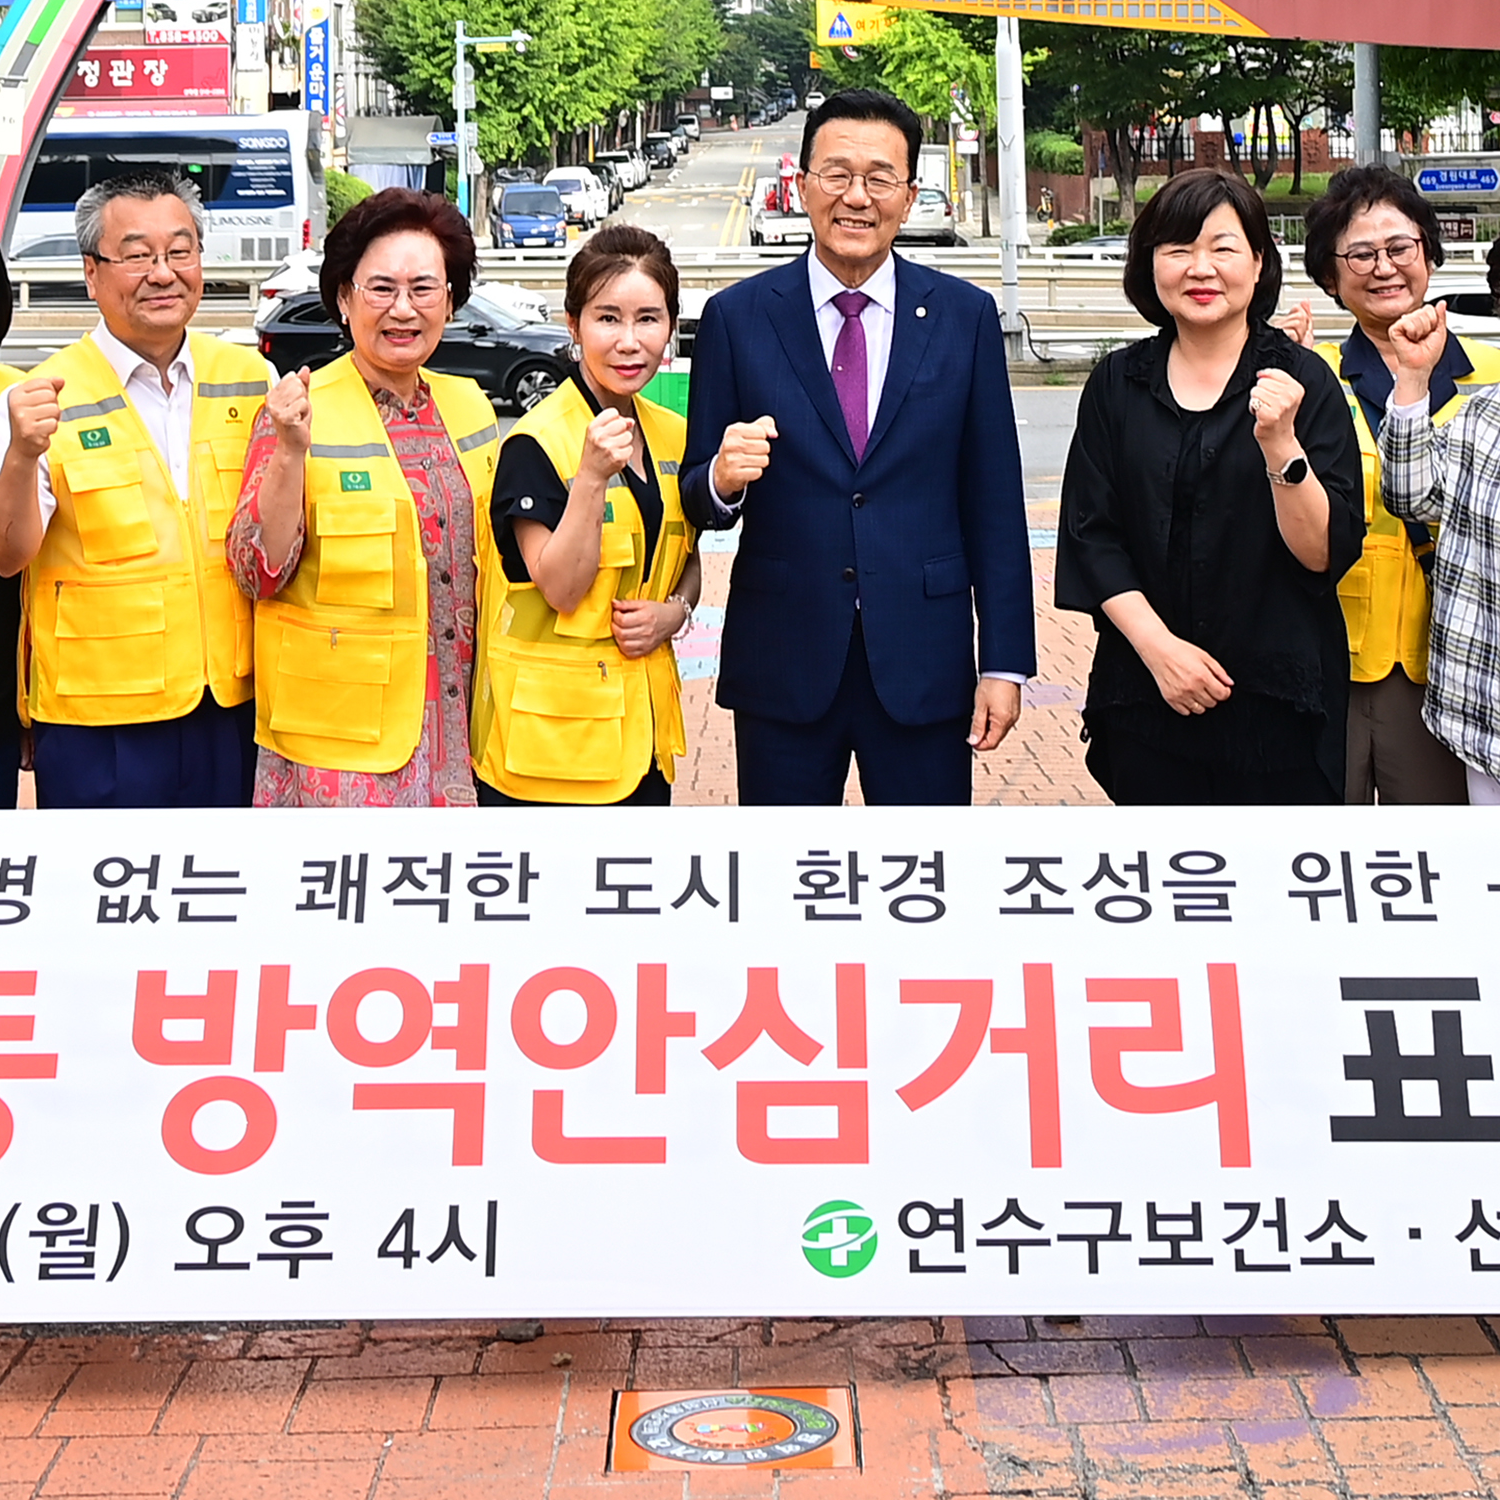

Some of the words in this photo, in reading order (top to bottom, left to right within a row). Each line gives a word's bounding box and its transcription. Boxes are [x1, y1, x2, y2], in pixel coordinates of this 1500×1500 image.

[77, 59, 168, 88] 정관장
[238, 137, 287, 149] SONGDO
[1421, 176, 1436, 186] 469
[1439, 170, 1478, 183] 경원대로
[1480, 174, 1496, 184] 465
[94, 855, 246, 923] 없는
[296, 852, 539, 923] 쾌적한
[586, 852, 738, 922] 도시
[794, 851, 946, 923] 환경
[1000, 851, 1236, 923] 조성을
[1289, 851, 1439, 922] 위한
[132, 963, 1252, 1175] 방역안심거리
[175, 1201, 333, 1278] 오후
[378, 1201, 498, 1278] 4시
[898, 1198, 1375, 1275] 연수구보건소
